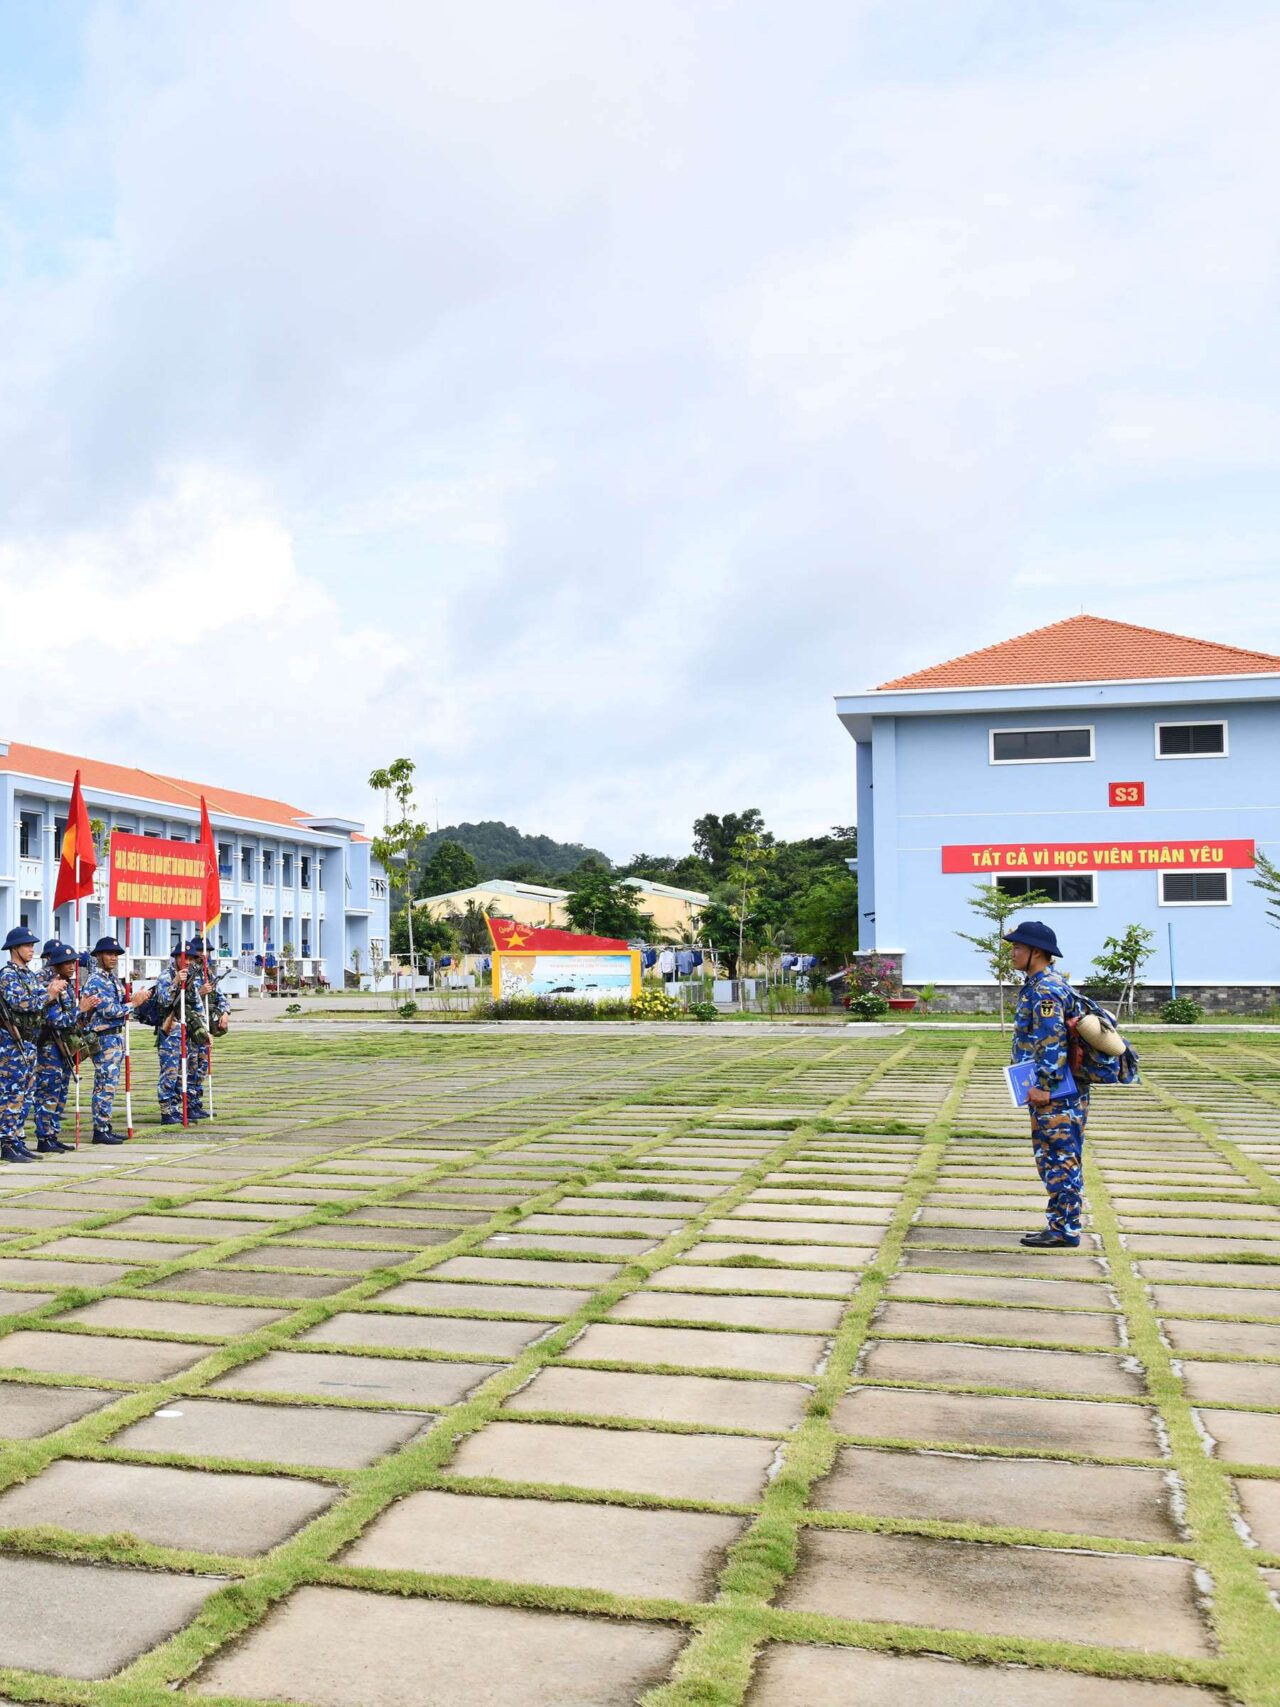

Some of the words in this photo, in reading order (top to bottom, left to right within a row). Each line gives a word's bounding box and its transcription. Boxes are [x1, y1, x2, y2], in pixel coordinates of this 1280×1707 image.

[1115, 787, 1138, 802] S3
[972, 848, 1001, 867] TẤT
[1006, 847, 1029, 866] CẢ
[1033, 848, 1049, 865] VÌ
[1054, 850, 1088, 868] HỌC
[1093, 846, 1133, 865] VIÊN
[1138, 845, 1185, 864] THÂN
[1189, 845, 1224, 863] YÊU
